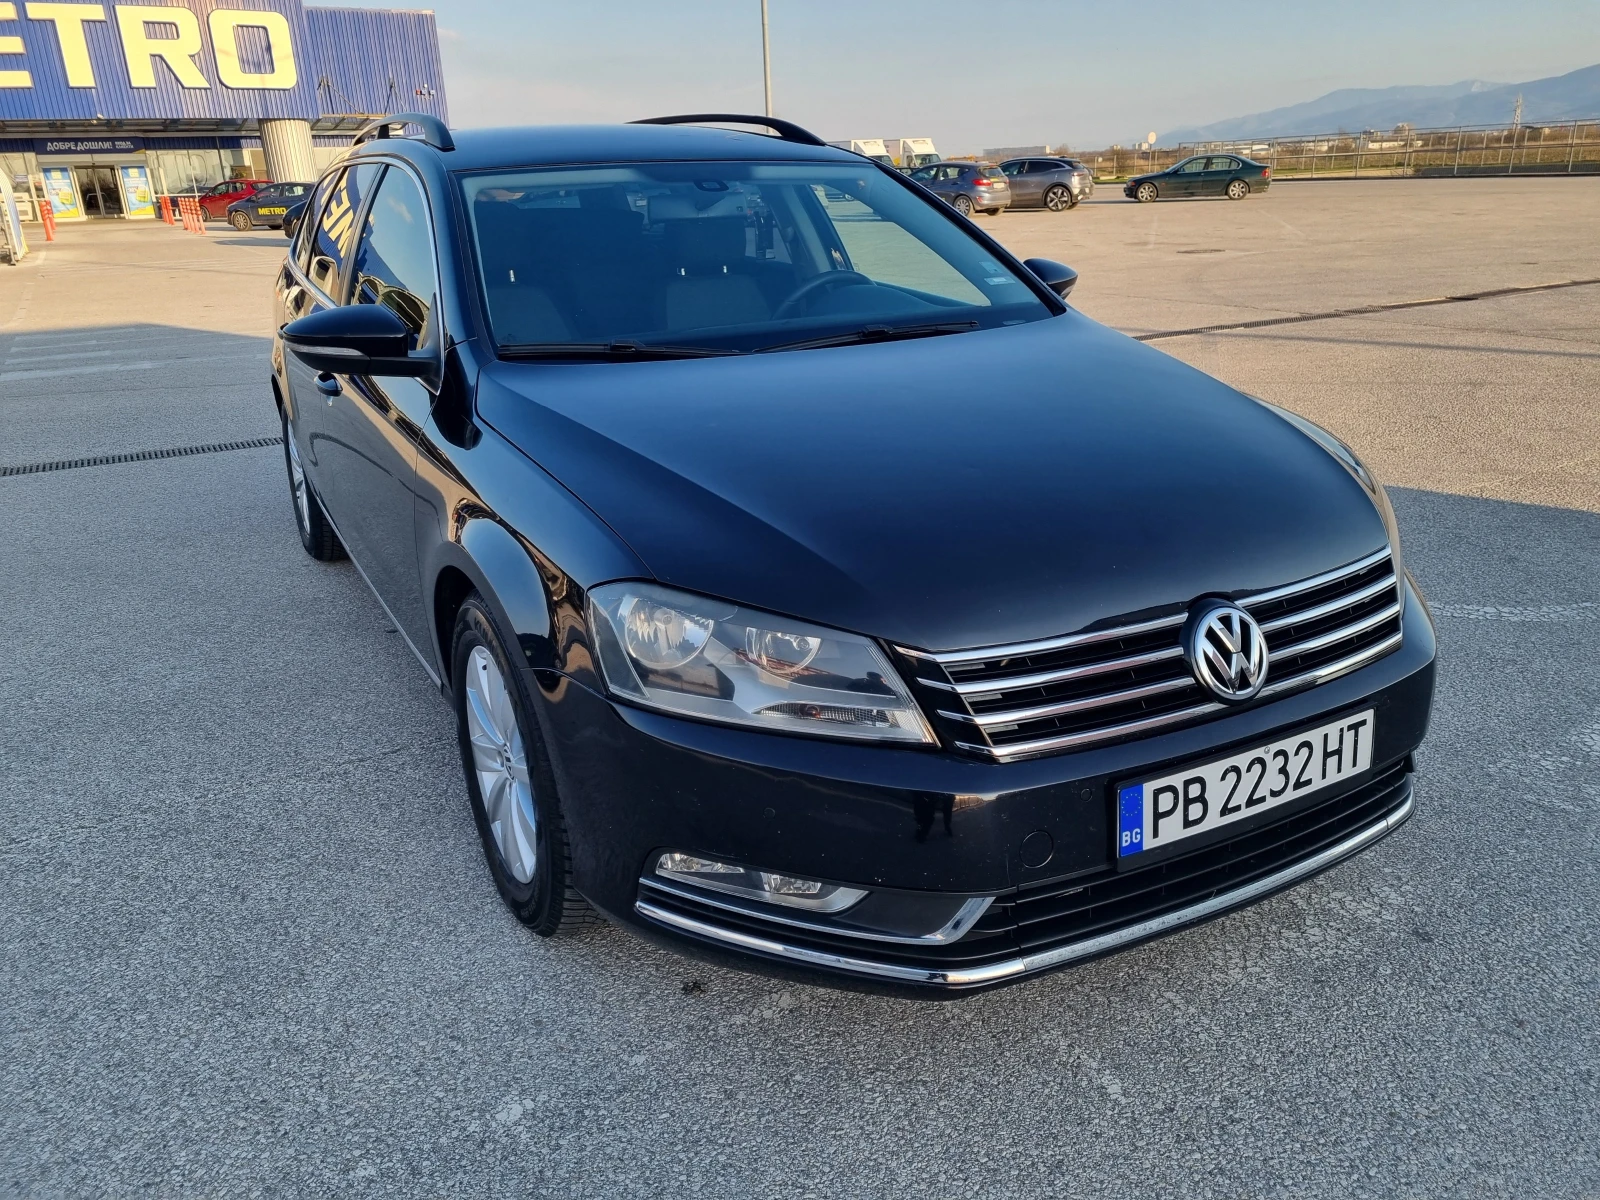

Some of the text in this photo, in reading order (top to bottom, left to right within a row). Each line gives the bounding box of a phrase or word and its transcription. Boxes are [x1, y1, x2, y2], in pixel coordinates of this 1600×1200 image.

[47, 141, 112, 151] ДОБРЕ ДОШЛИ!
[257, 207, 286, 215] METRO
[1152, 719, 1367, 839] PB 2232 HT
[1122, 827, 1141, 847] BG
